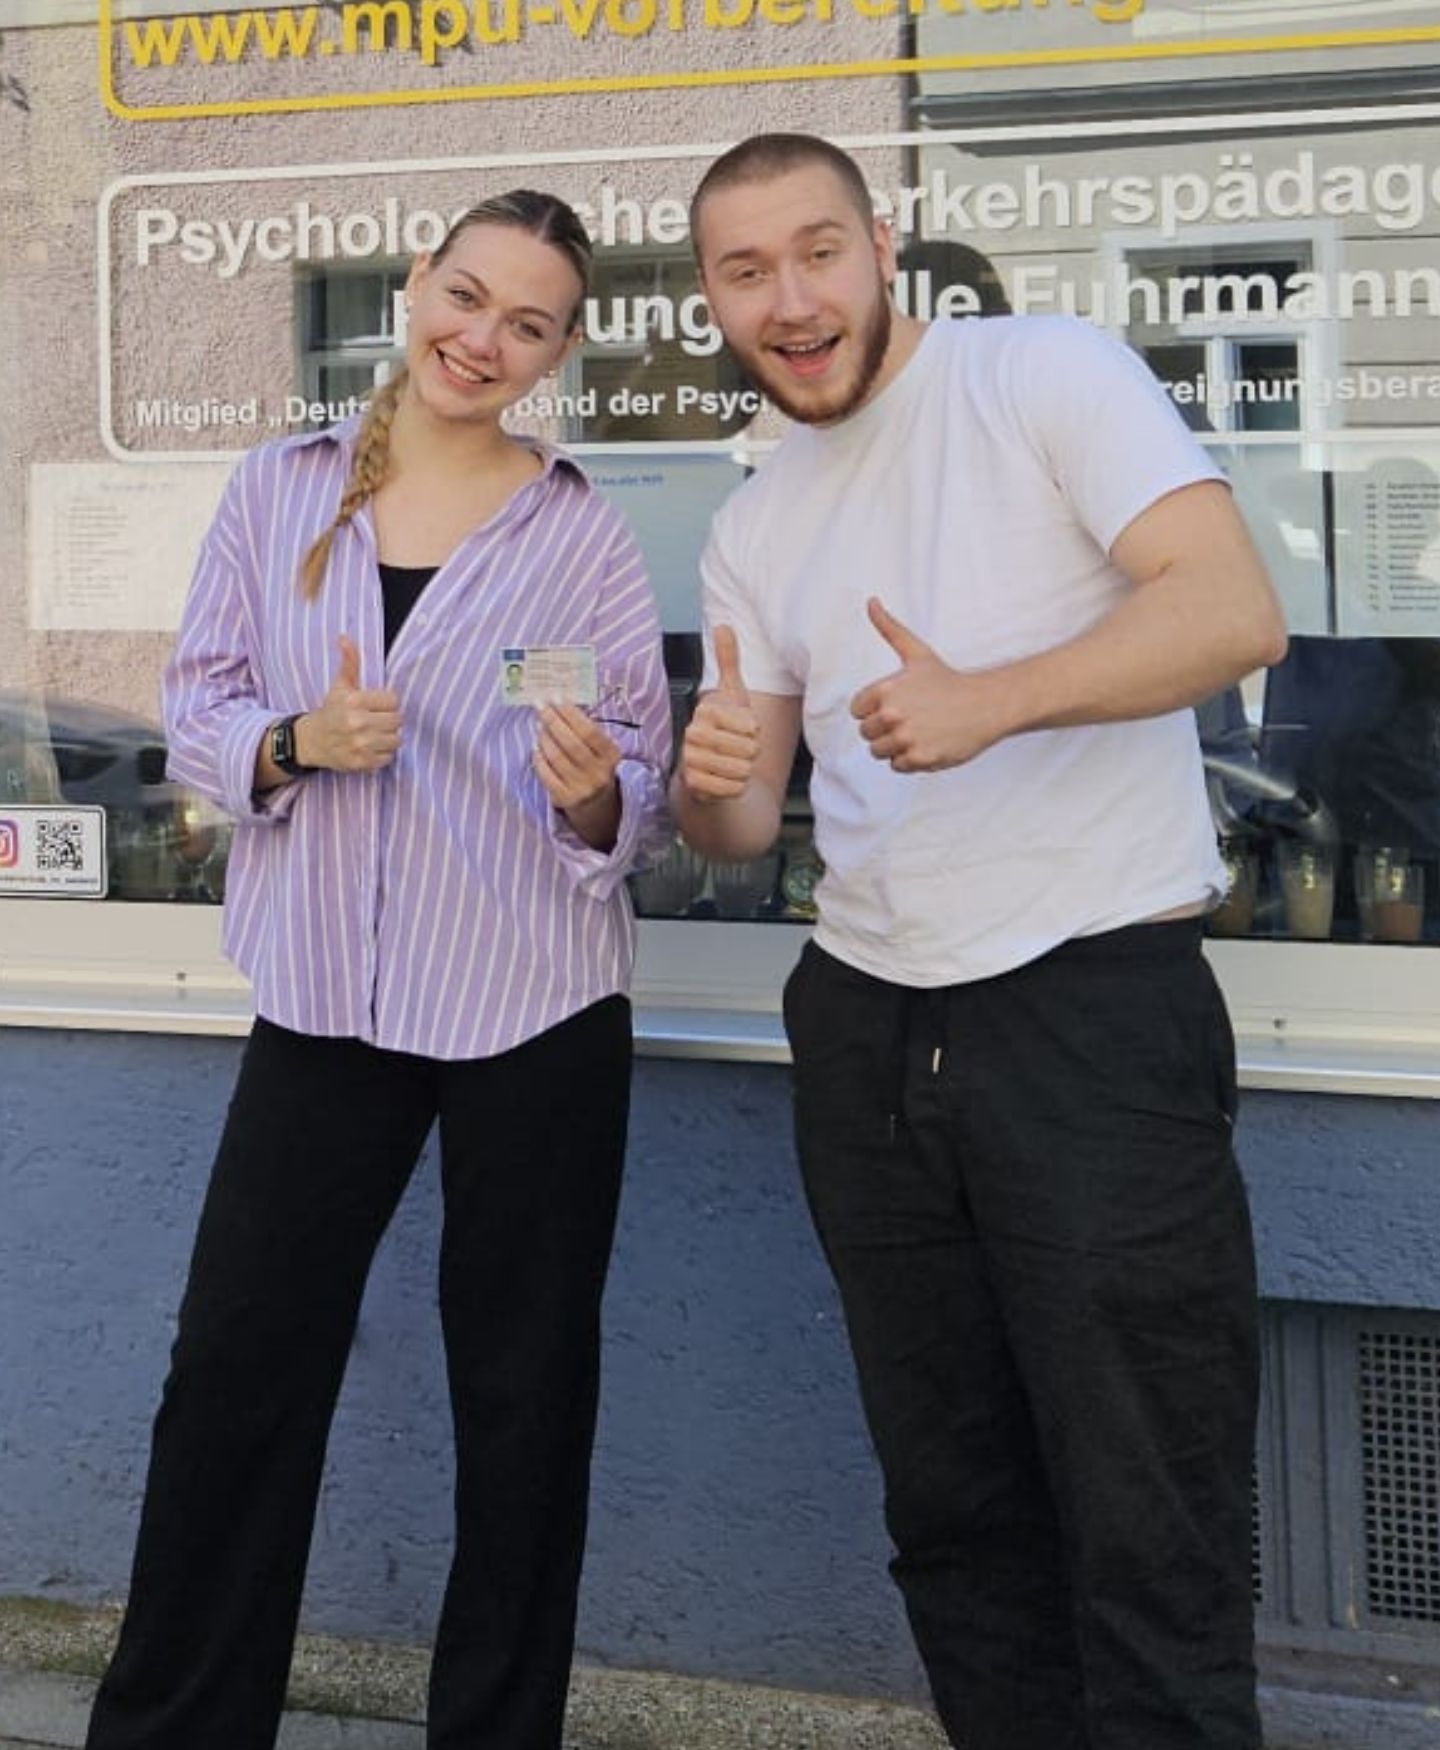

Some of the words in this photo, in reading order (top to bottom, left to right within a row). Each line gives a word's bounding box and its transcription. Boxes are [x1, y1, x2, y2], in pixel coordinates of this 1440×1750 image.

[125, 0, 1146, 68] www.mpu-vore
[136, 186, 690, 278] Psycholohe
[871, 151, 1440, 237] rkehrspädag
[1012, 261, 1440, 326] Fuhrmann
[136, 398, 258, 432] Mitglied
[608, 387, 666, 416] der
[676, 385, 771, 422] Psyc
